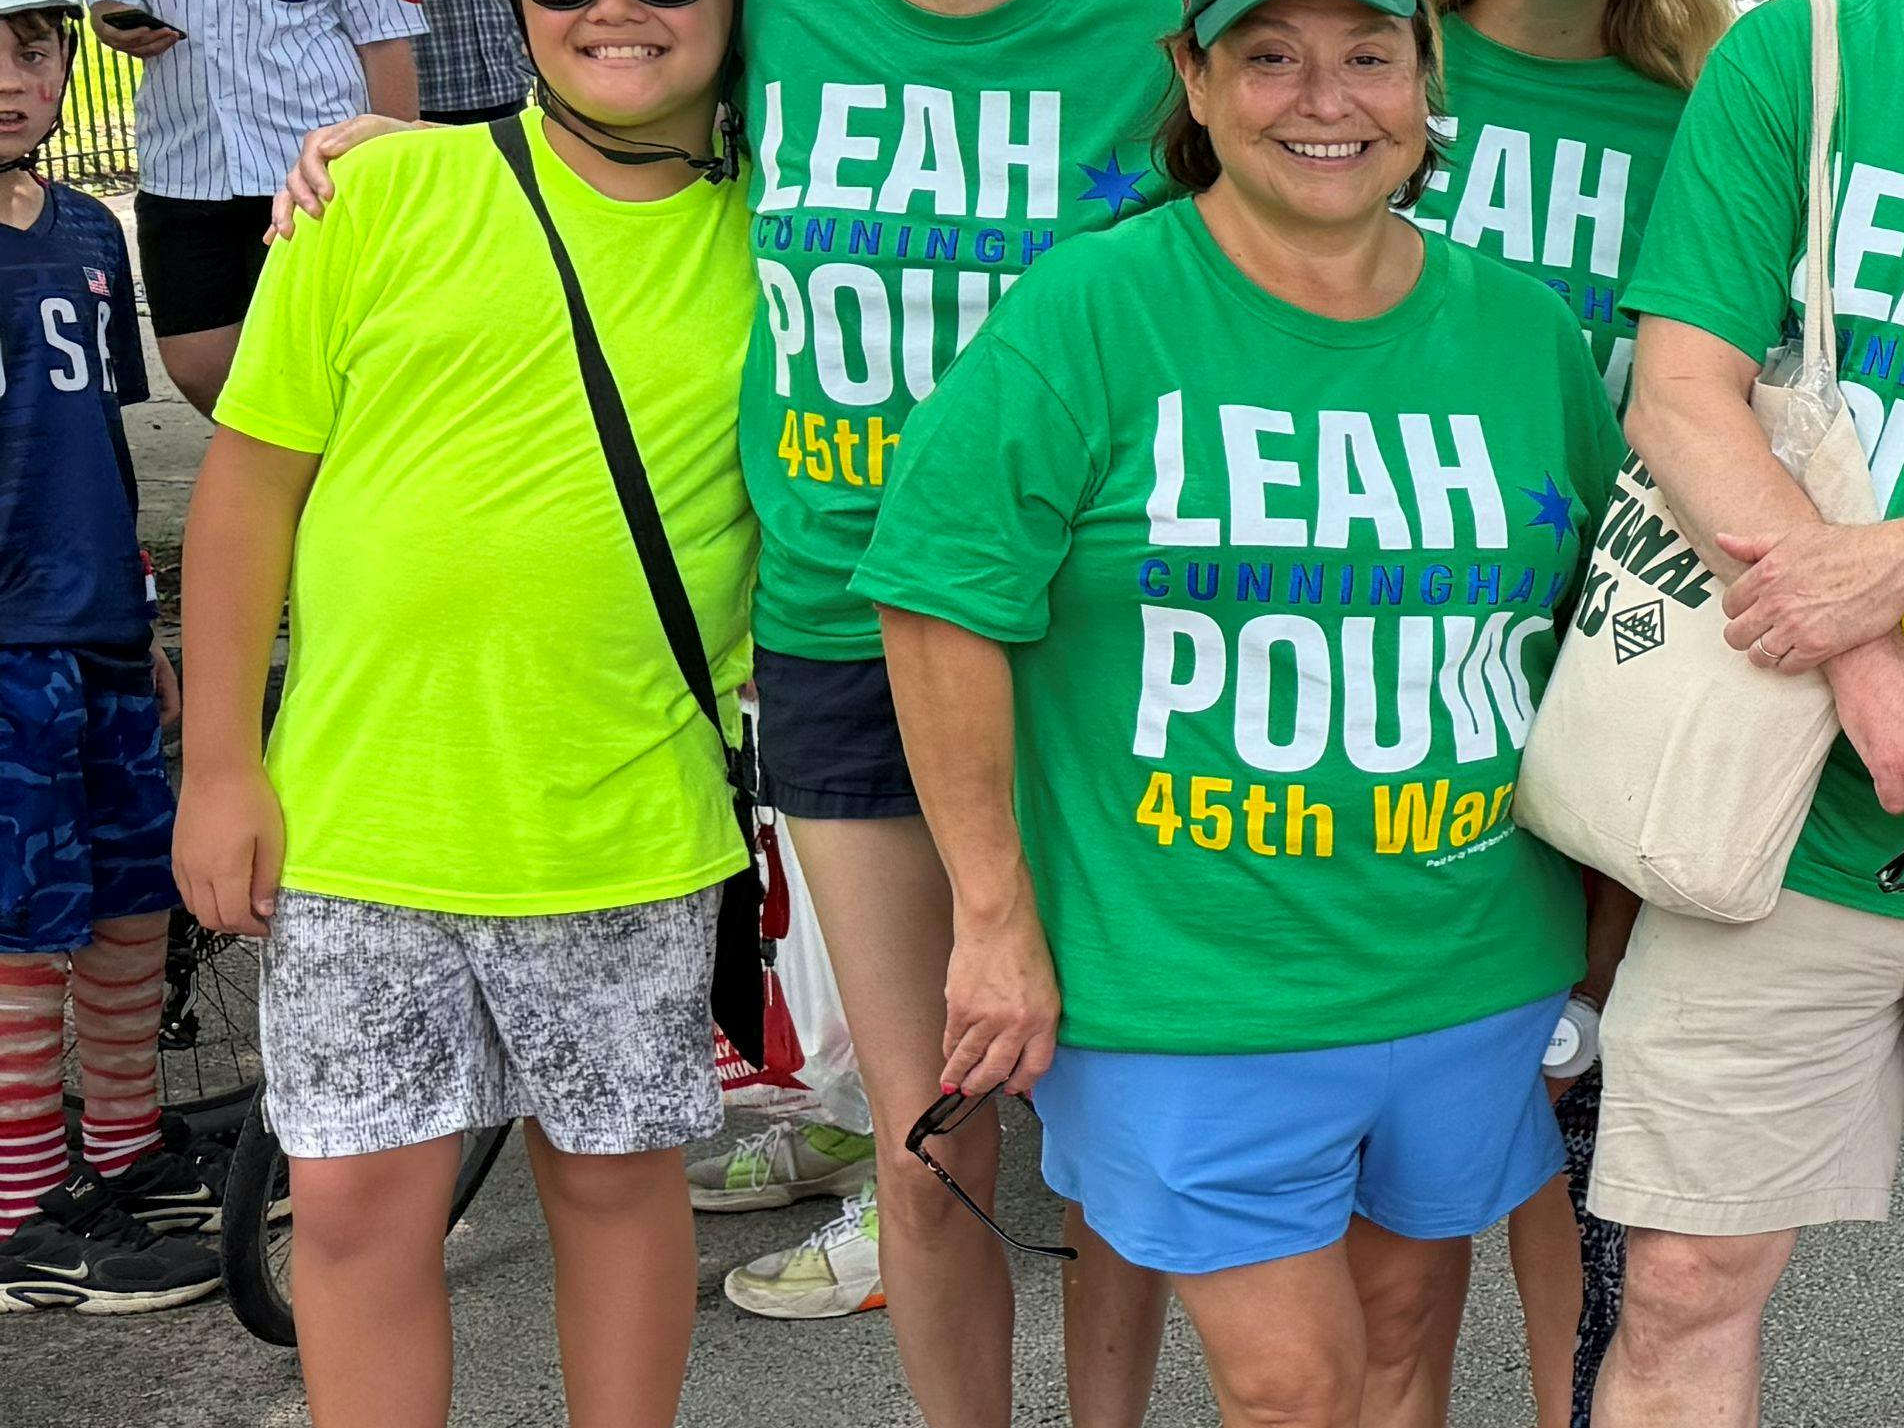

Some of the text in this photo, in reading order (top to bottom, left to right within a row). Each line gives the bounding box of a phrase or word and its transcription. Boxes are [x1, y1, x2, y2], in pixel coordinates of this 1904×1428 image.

[756, 71, 1061, 220] LEAH
[756, 215, 1054, 265] CUNNINGH
[757, 257, 1021, 407] POU
[778, 409, 901, 486] 45th
[1147, 387, 1509, 551] LEAH
[1135, 770, 1333, 858] 45th
[1373, 777, 1514, 855] War
